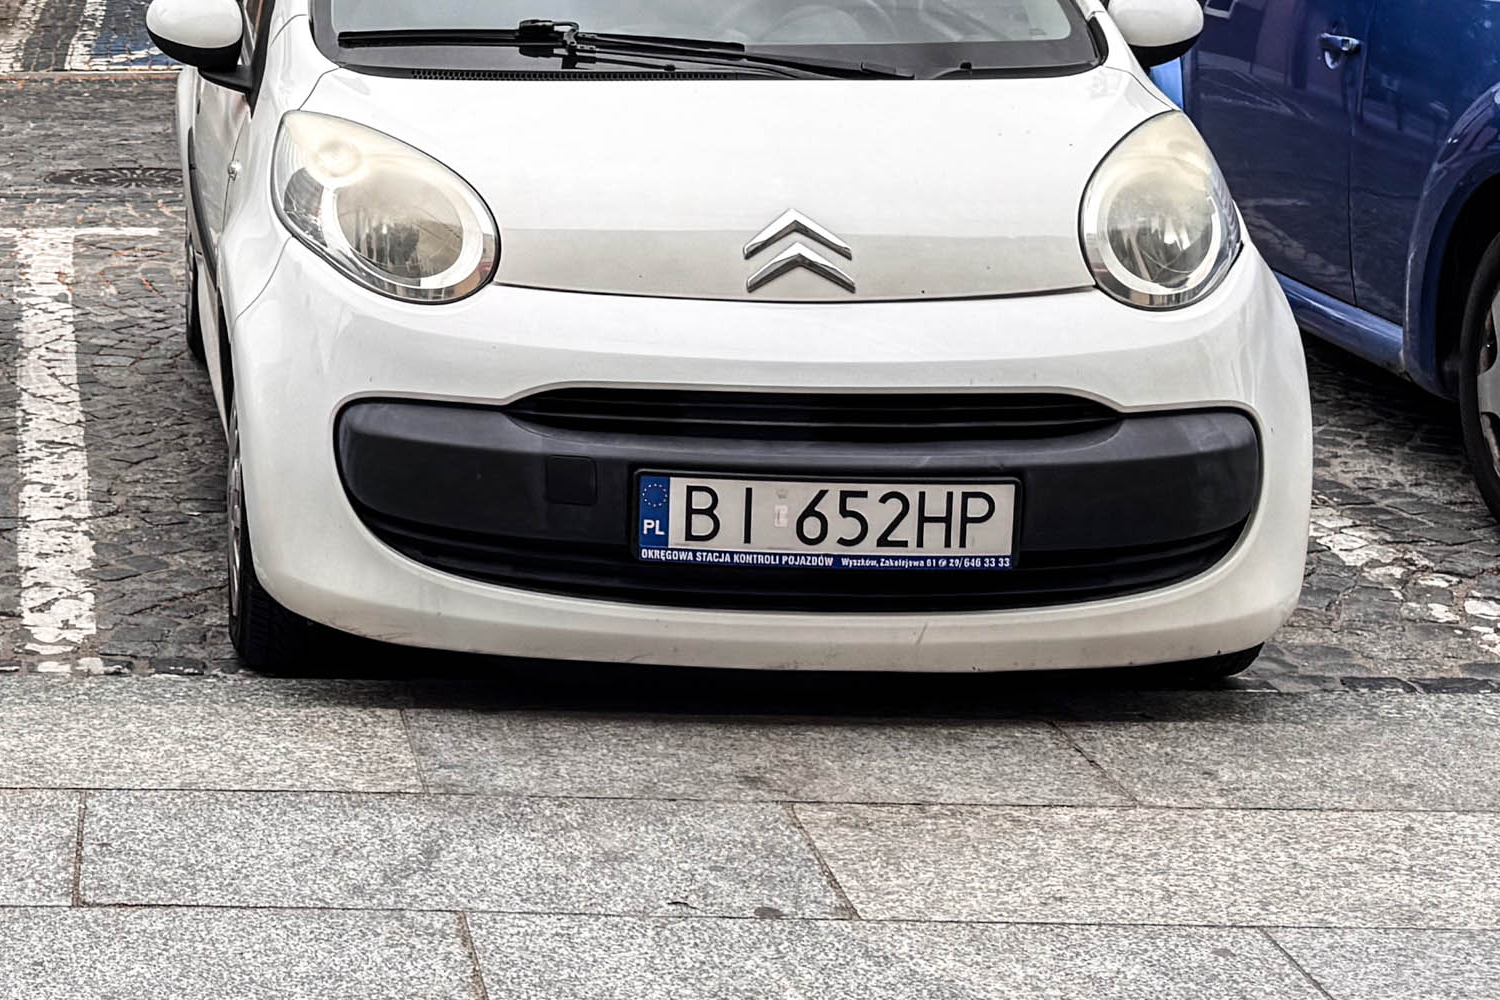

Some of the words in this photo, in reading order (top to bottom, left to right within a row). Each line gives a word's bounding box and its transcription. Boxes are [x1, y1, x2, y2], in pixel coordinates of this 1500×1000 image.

[684, 484, 753, 545] BI
[796, 488, 996, 549] 652HP
[643, 519, 665, 537] PL
[641, 548, 694, 561] OKRĘGOWA
[696, 551, 731, 564] STACJA
[733, 553, 780, 565] KONTROLI
[782, 554, 834, 567] POJAZDÓW
[984, 557, 996, 568] 33
[998, 557, 1010, 568] 33
